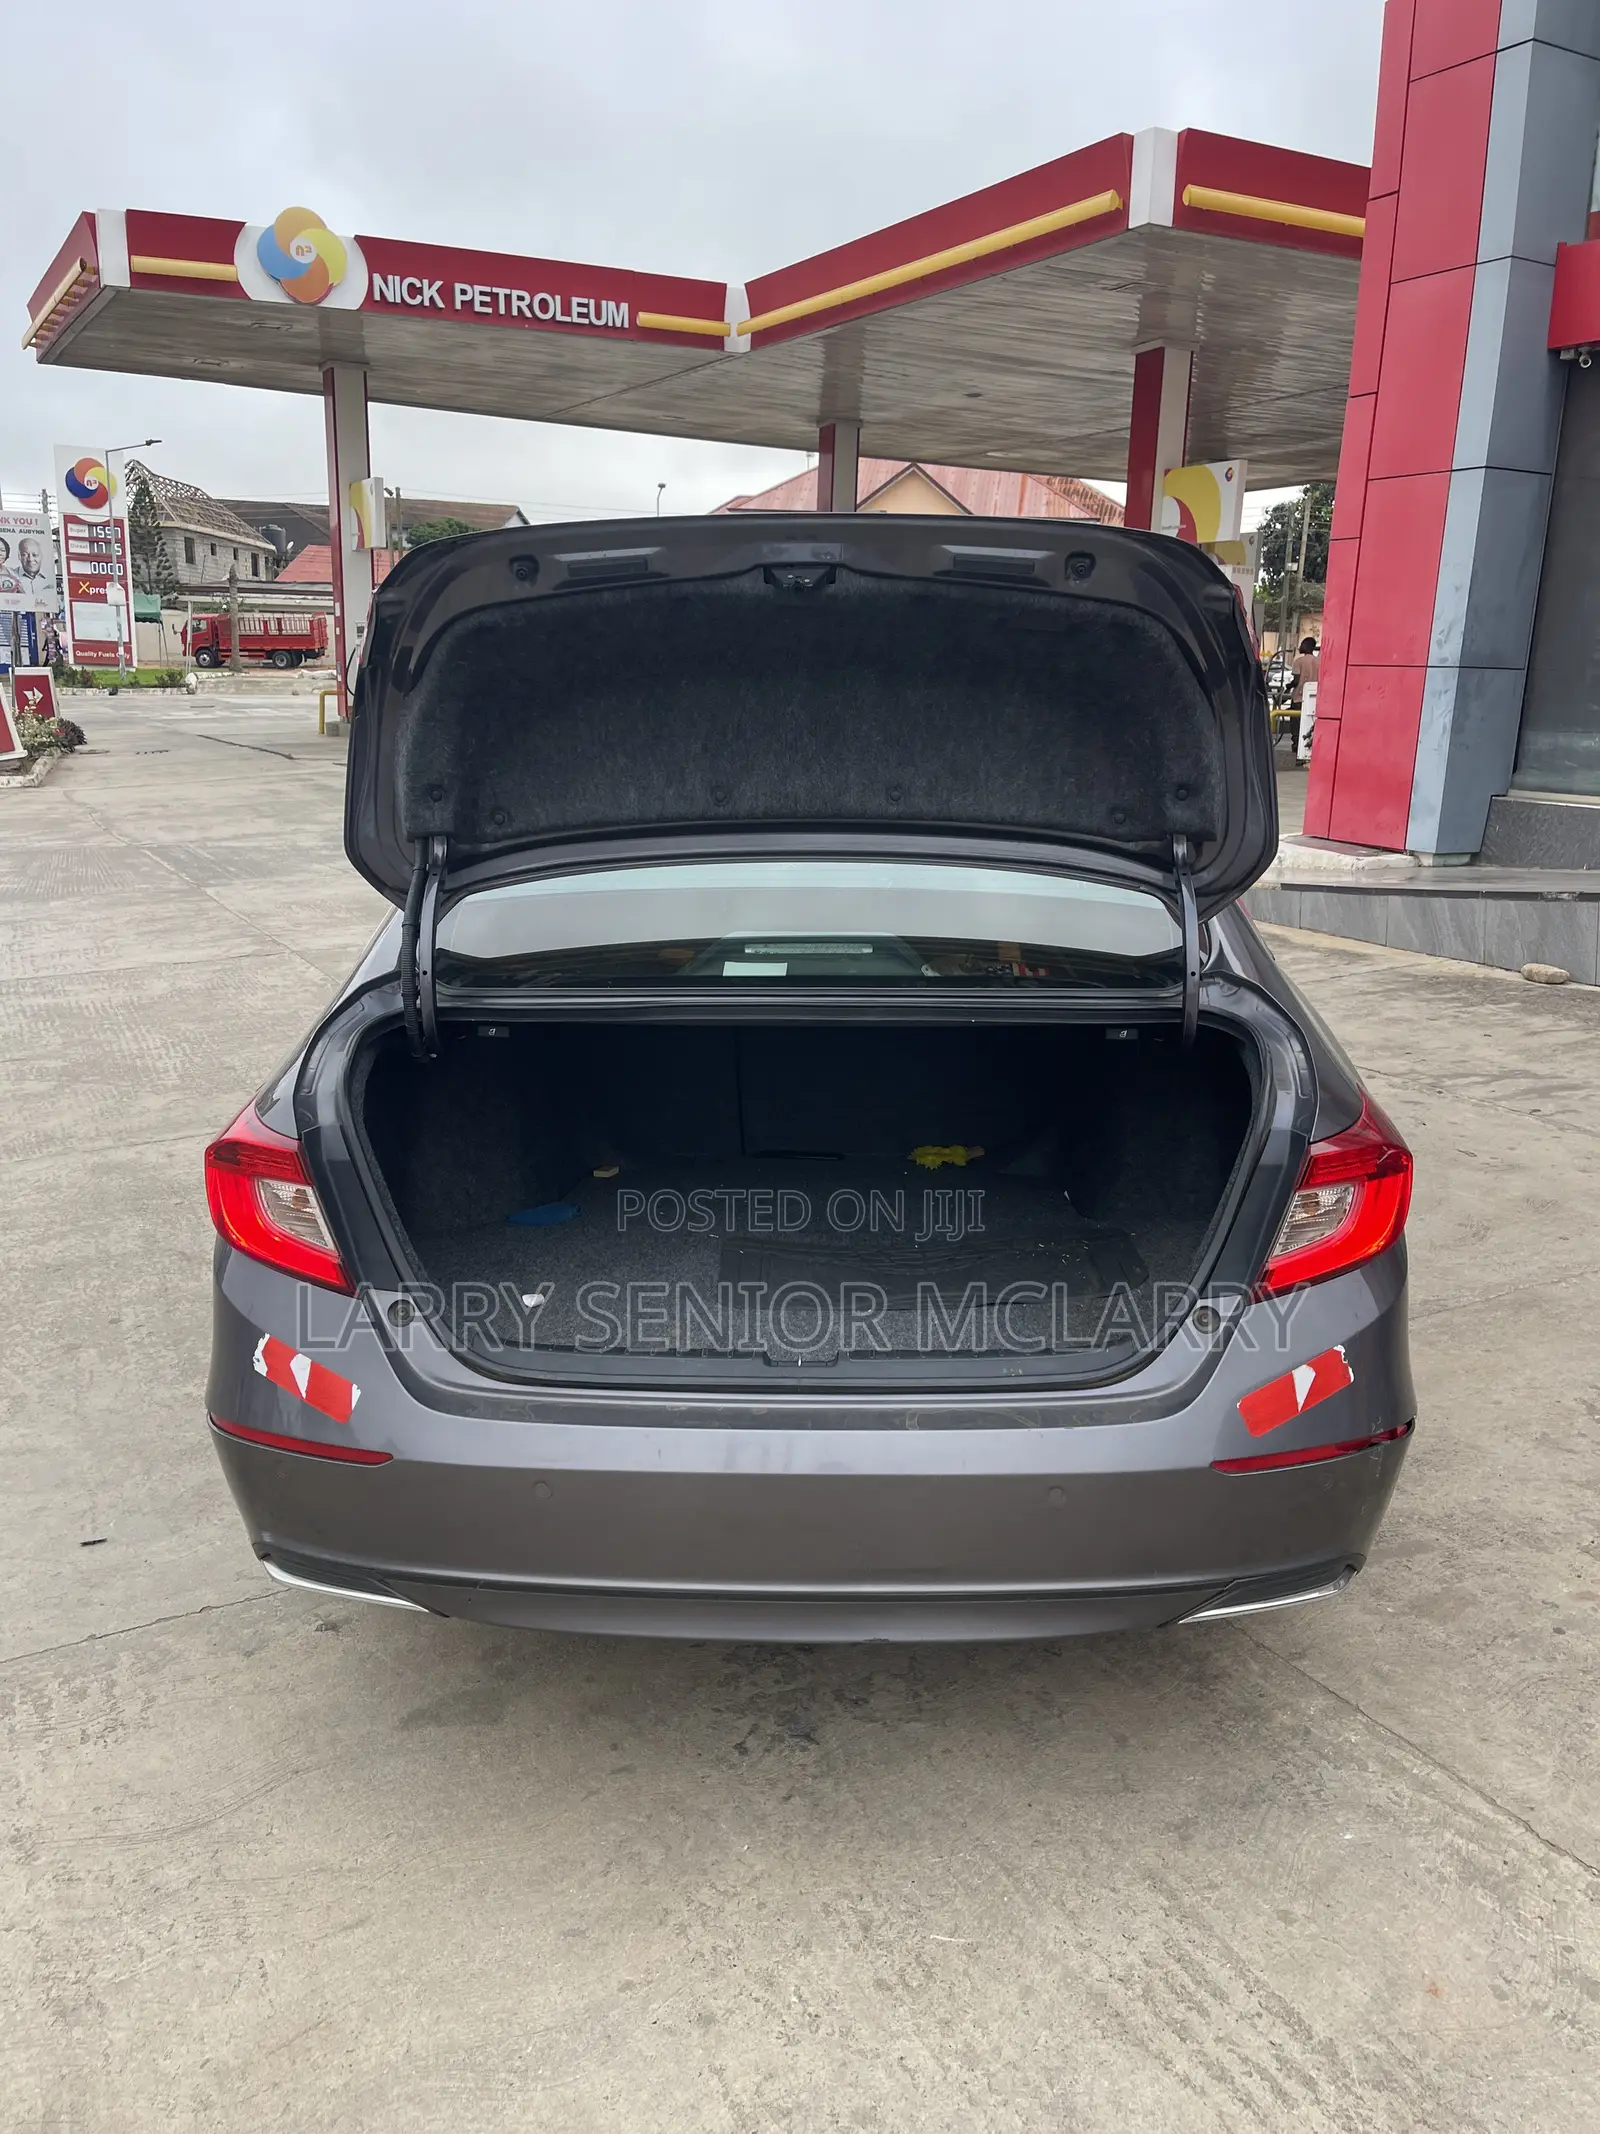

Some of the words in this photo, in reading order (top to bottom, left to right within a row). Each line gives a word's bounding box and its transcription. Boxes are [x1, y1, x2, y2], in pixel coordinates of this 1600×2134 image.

[372, 272, 445, 309] NICK
[453, 282, 630, 329] PETROLEUM
[94, 542, 122, 556] 175
[78, 581, 108, 595] Xpre
[75, 650, 98, 658] Quality
[116, 652, 130, 660] Oly
